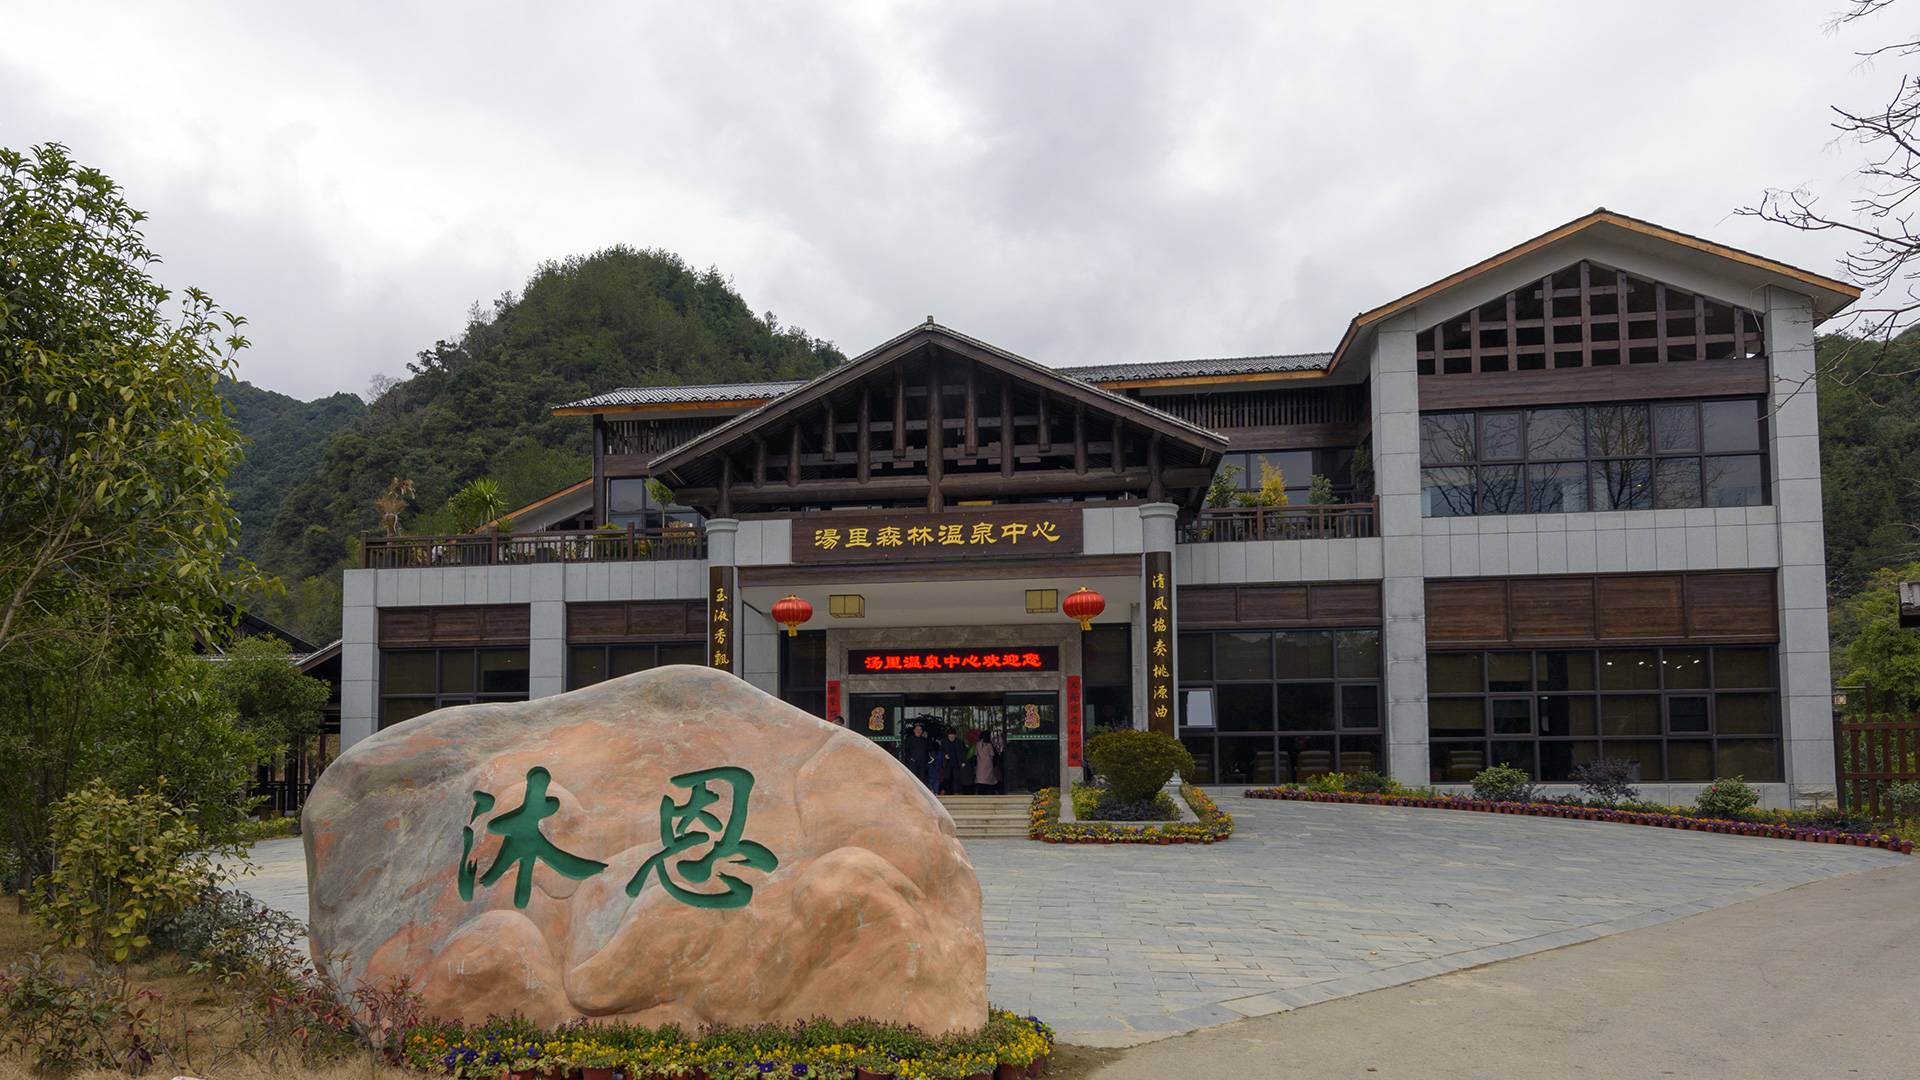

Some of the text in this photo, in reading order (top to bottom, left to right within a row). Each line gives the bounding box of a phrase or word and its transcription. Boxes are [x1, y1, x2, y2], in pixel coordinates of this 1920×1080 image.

[814, 521, 1061, 550] 湯里森林温泉中心
[864, 652, 1043, 670] 汤里温泉中心欢迎您
[458, 766, 780, 910] 沐恩
